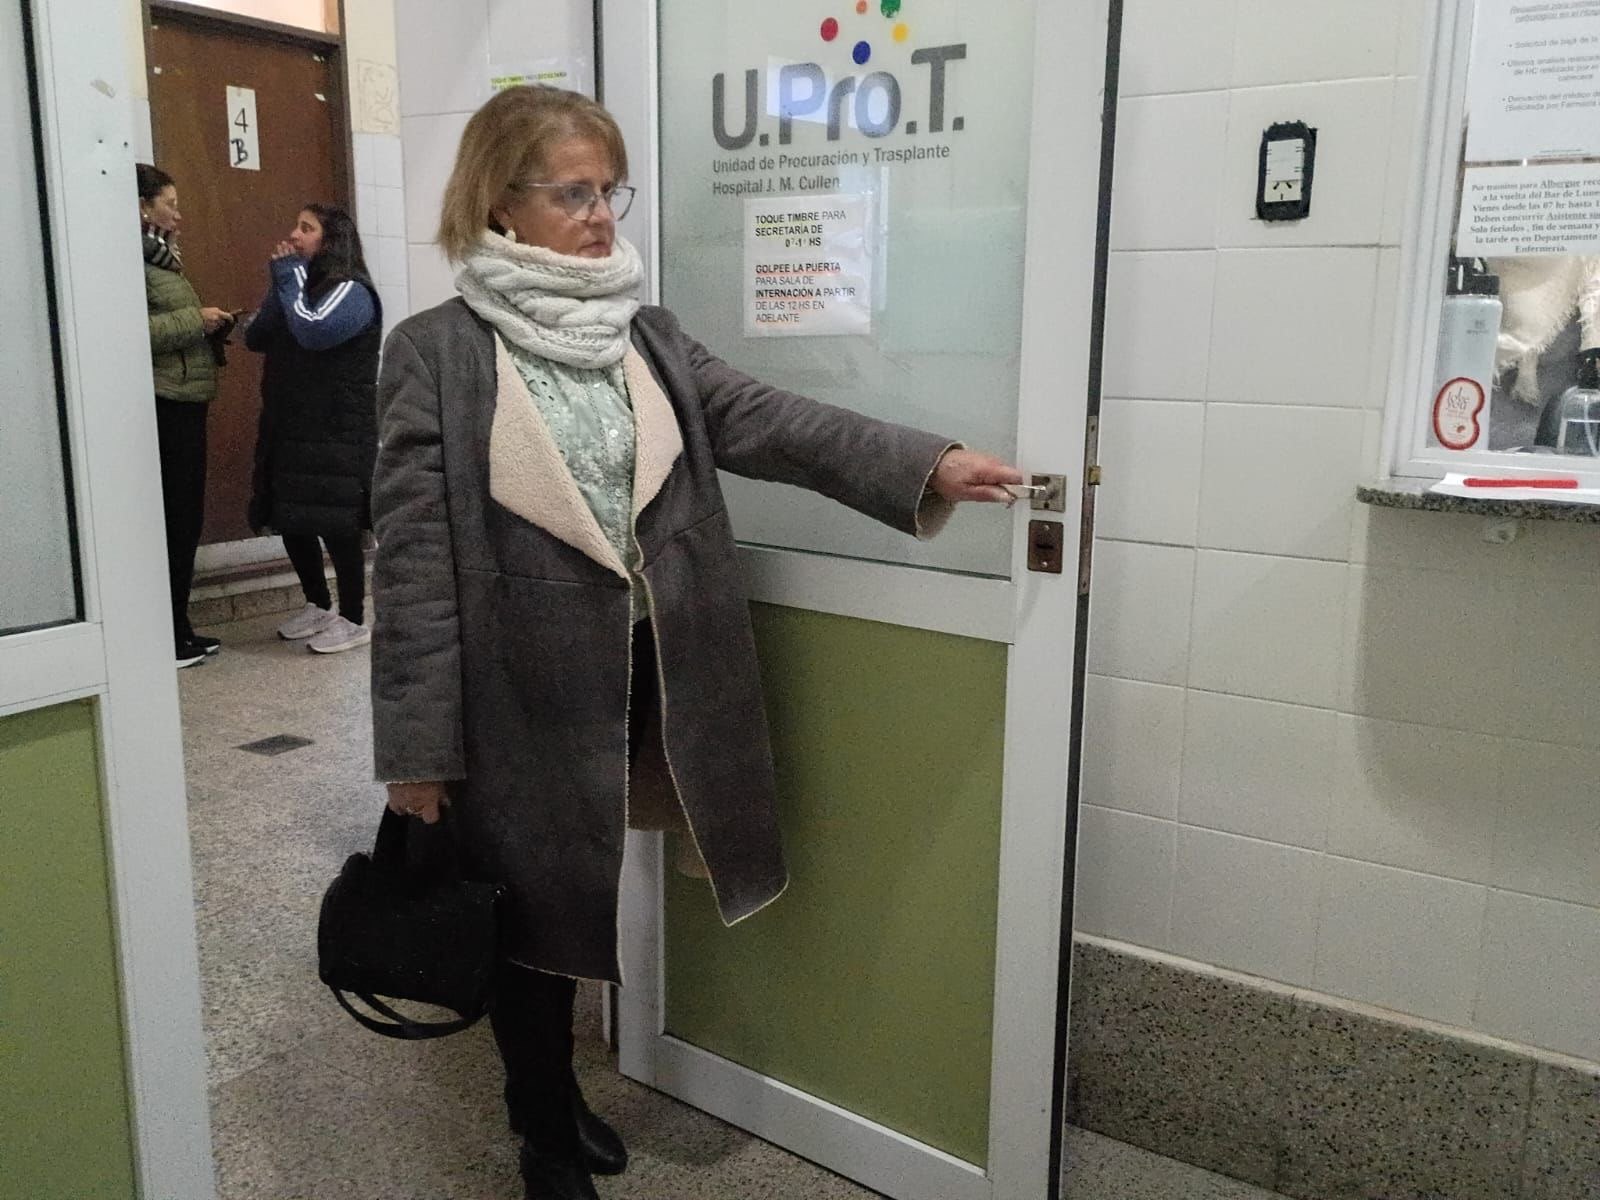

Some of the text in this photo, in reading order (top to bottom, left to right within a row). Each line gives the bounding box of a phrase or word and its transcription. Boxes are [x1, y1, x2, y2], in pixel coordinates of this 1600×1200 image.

[234, 107, 249, 134] 4
[230, 138, 249, 167] B
[713, 144, 950, 173] Unidad de Procuración y Trasplante
[712, 174, 840, 196] Hospital J. M. Cullen
[1490, 193, 1498, 201] la
[1500, 192, 1526, 200] vuelta
[1529, 190, 1541, 199] del
[1563, 189, 1573, 197] de
[1502, 202, 1526, 211] desde
[1529, 202, 1540, 210] las
[1568, 200, 1592, 208] hasta
[755, 210, 847, 224] TOQUE TIMBRE PARA
[1474, 215, 1501, 223] Deben
[811, 225, 823, 234] DE
[1532, 223, 1544, 231] fin
[1546, 222, 1557, 231] de
[809, 237, 821, 247] HS
[1475, 235, 1483, 244] la
[1486, 235, 1508, 243] tarde
[1534, 234, 1598, 243] Departamento
[755, 262, 841, 274] GOLPEE LA PUERTA
[755, 276, 814, 285] PARA SALA DE
[755, 287, 856, 298] INTERNACIÓN A PARTIR
[755, 300, 825, 310] DE LAS 12 HS EN
[755, 313, 800, 323] ADELANTE
